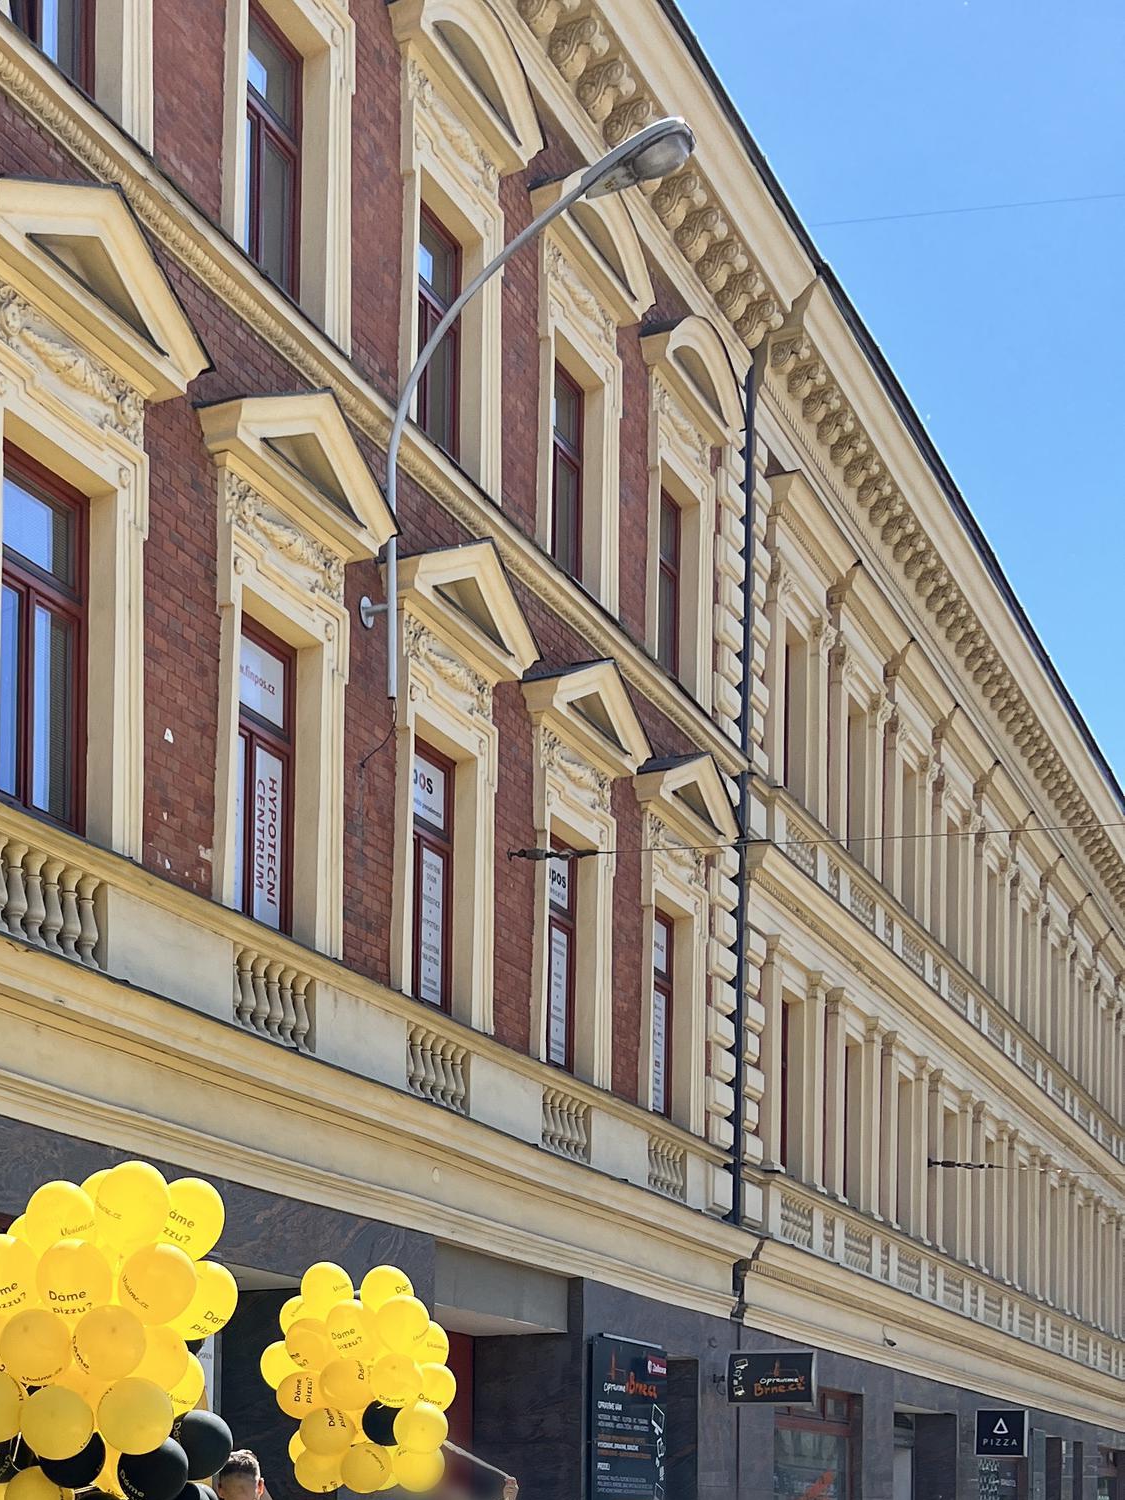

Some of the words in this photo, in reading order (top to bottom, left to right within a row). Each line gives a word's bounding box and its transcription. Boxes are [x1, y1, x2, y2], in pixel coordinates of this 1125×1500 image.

[255, 778, 266, 889] CENTRUM
[266, 776, 277, 906] HYPOTEČNÍ
[168, 1208, 196, 1229] áme
[162, 1226, 192, 1245] zzu?
[982, 1438, 1019, 1447] PIZZA
[119, 1468, 145, 1499] Dáme
